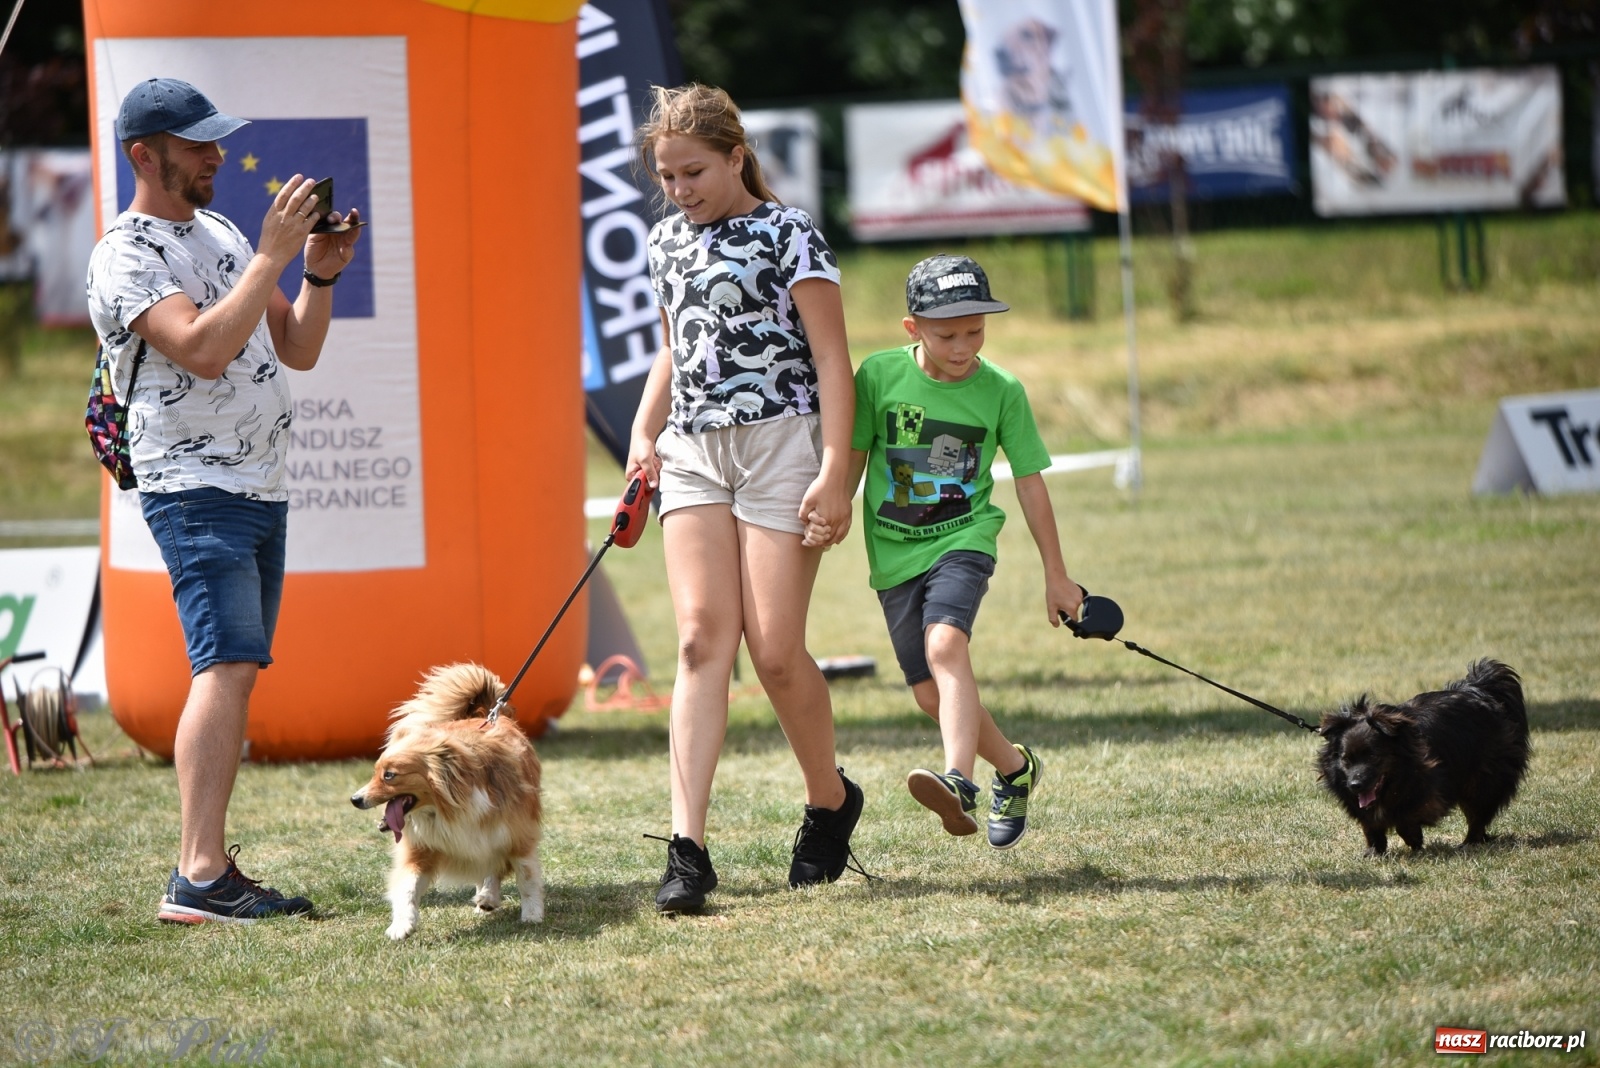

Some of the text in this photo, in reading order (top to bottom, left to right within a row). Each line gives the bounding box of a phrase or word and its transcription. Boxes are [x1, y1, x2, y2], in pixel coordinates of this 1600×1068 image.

[937, 272, 978, 291] MARVEL
[290, 427, 383, 450] NDUSZ
[1529, 406, 1600, 468] Tr
[288, 485, 408, 511] GRANICE
[935, 514, 975, 533] ATTITUDE
